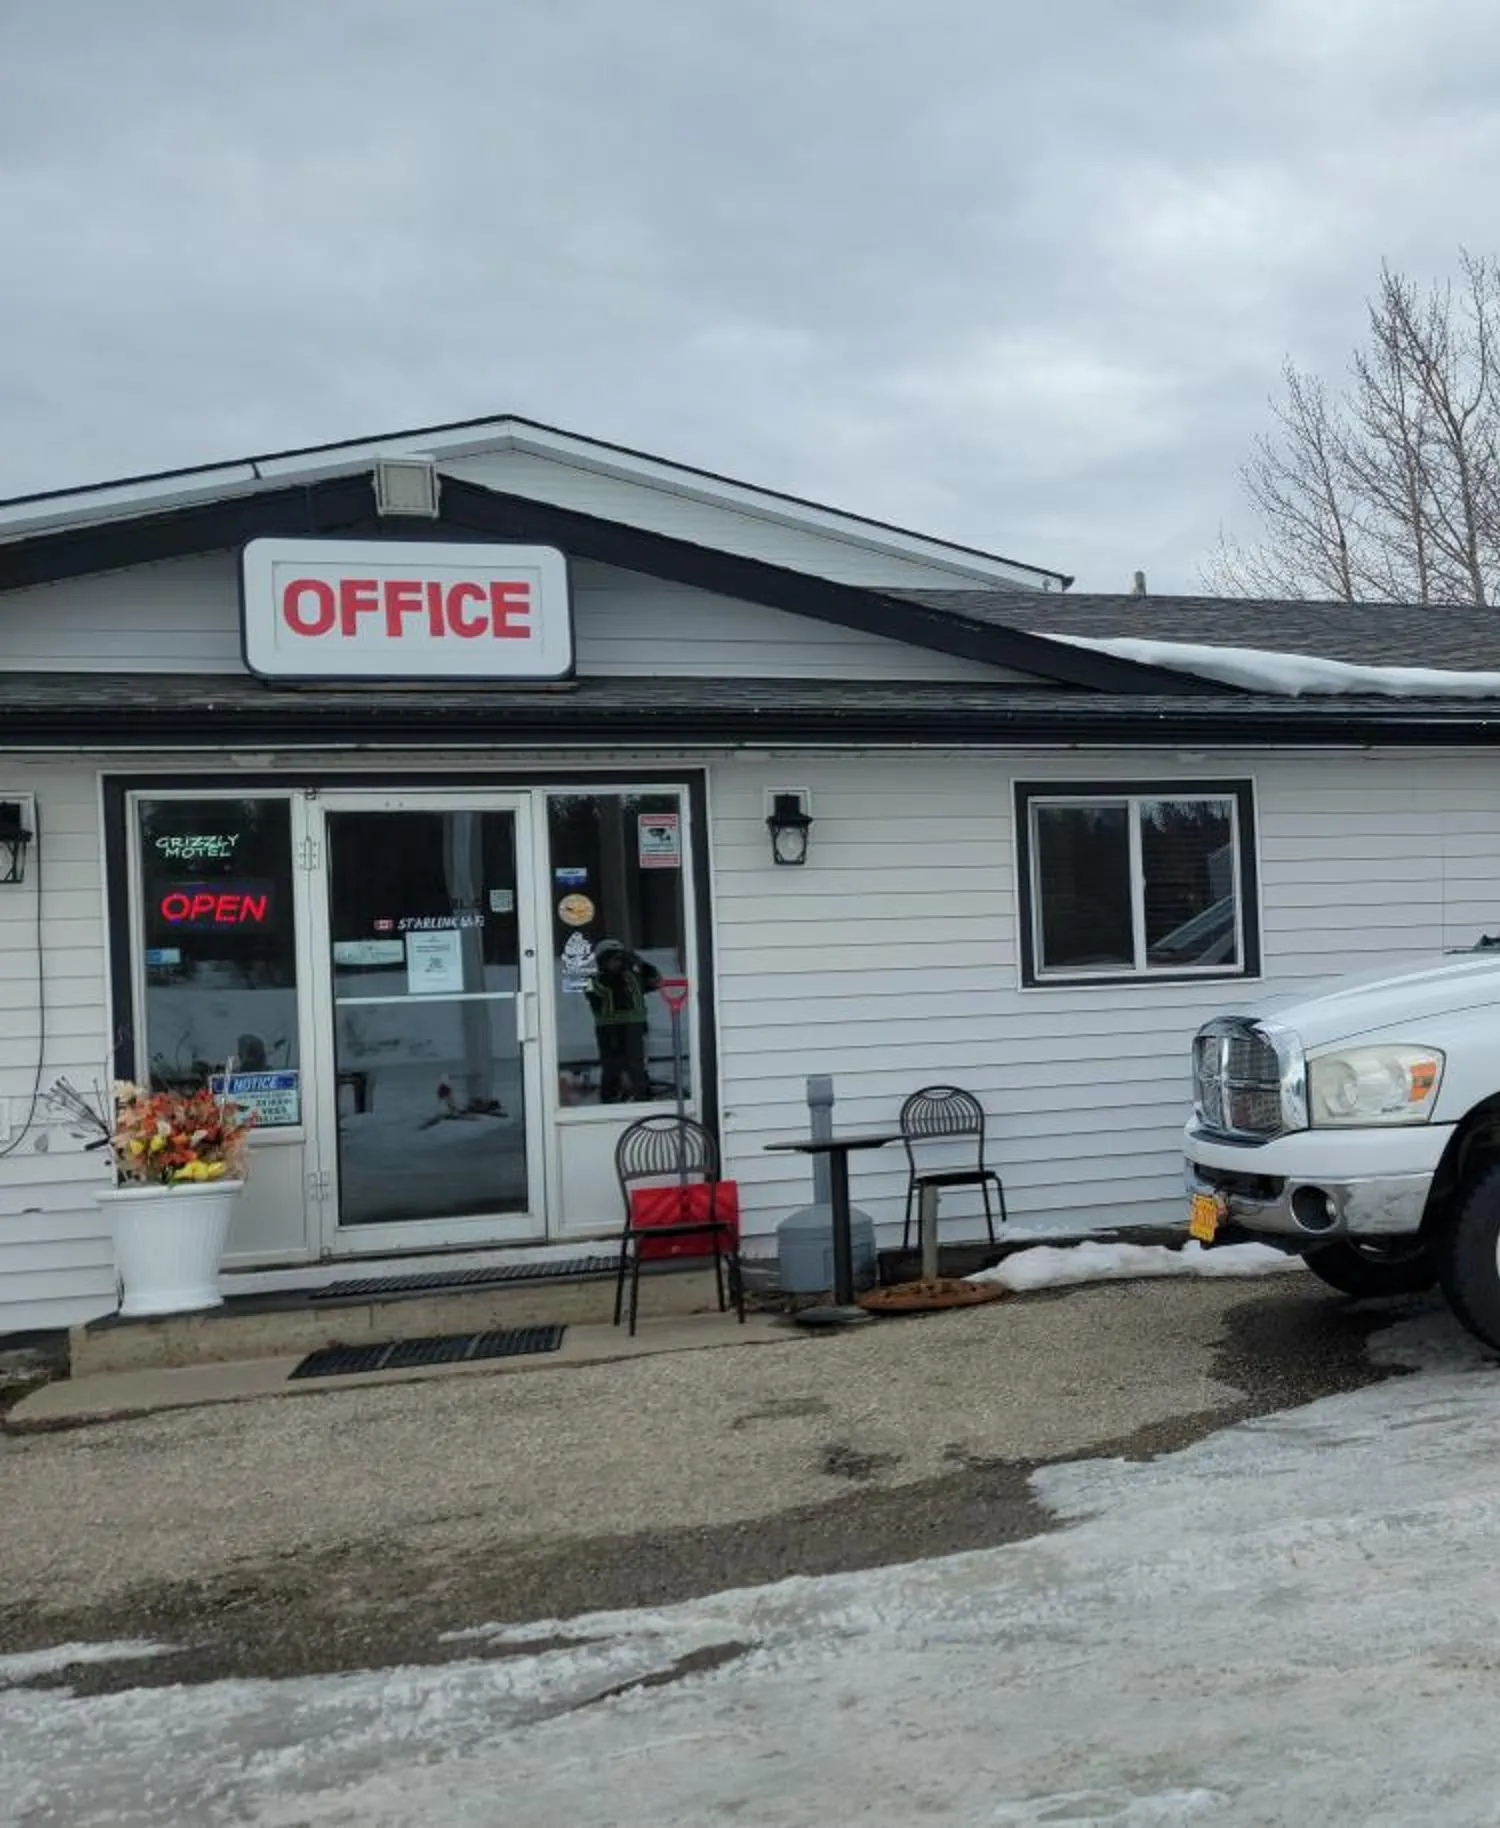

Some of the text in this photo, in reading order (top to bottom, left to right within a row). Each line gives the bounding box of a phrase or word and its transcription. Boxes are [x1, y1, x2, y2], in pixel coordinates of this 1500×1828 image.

[283, 578, 531, 639] OFFICE
[155, 833, 239, 849] GRIZZLY
[165, 846, 232, 859] MOTEL
[161, 893, 268, 923] OPEN
[234, 1076, 279, 1094] NOTICE
